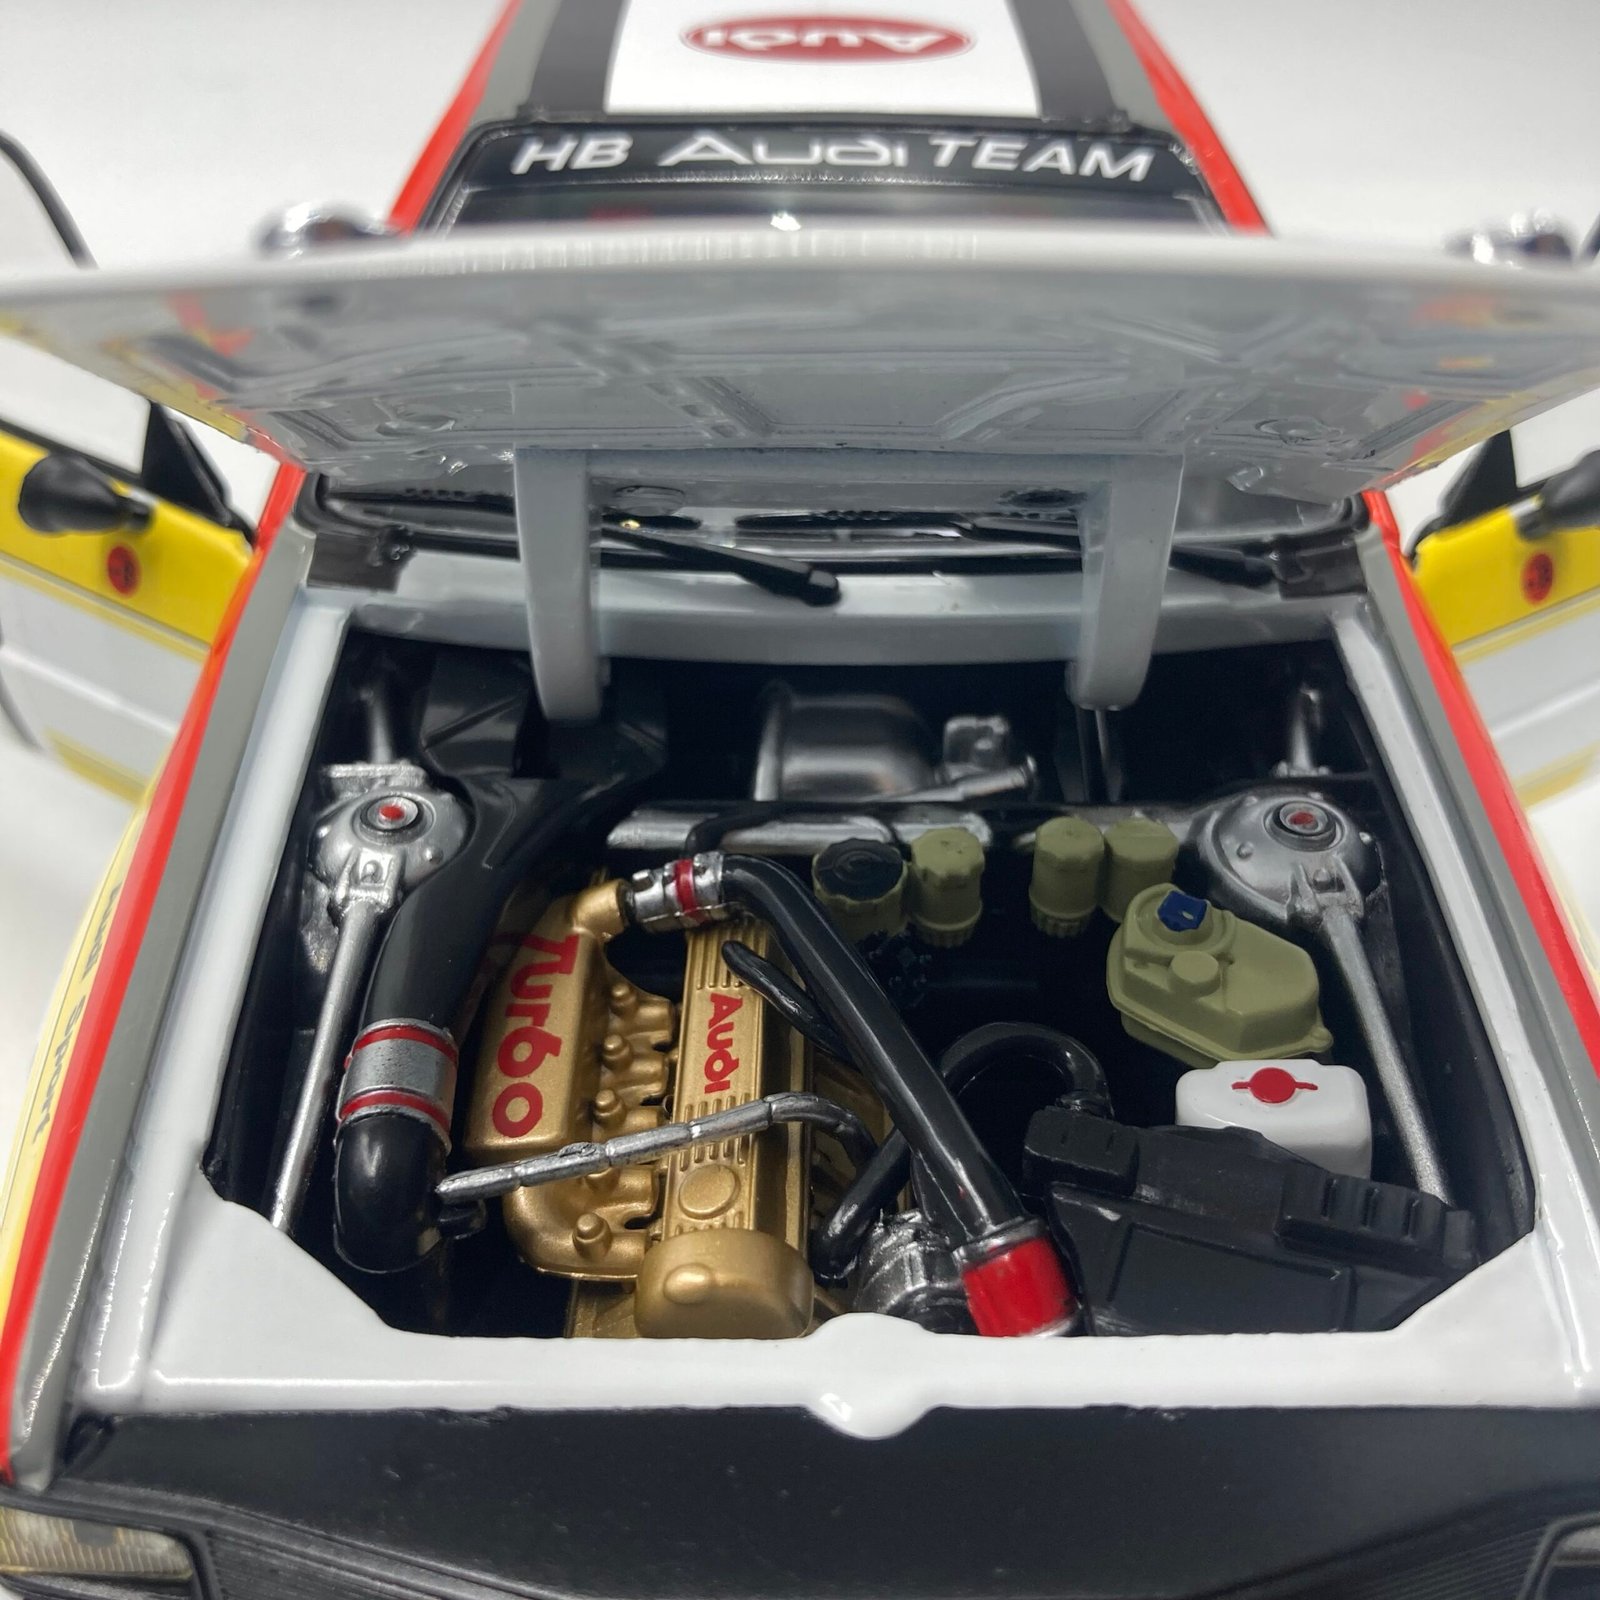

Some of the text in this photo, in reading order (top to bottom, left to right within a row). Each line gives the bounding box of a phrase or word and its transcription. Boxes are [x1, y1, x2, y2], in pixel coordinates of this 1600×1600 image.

[510, 132, 633, 175] HB
[929, 135, 1155, 182] TEAM
[492, 934, 580, 1138] Turbo
